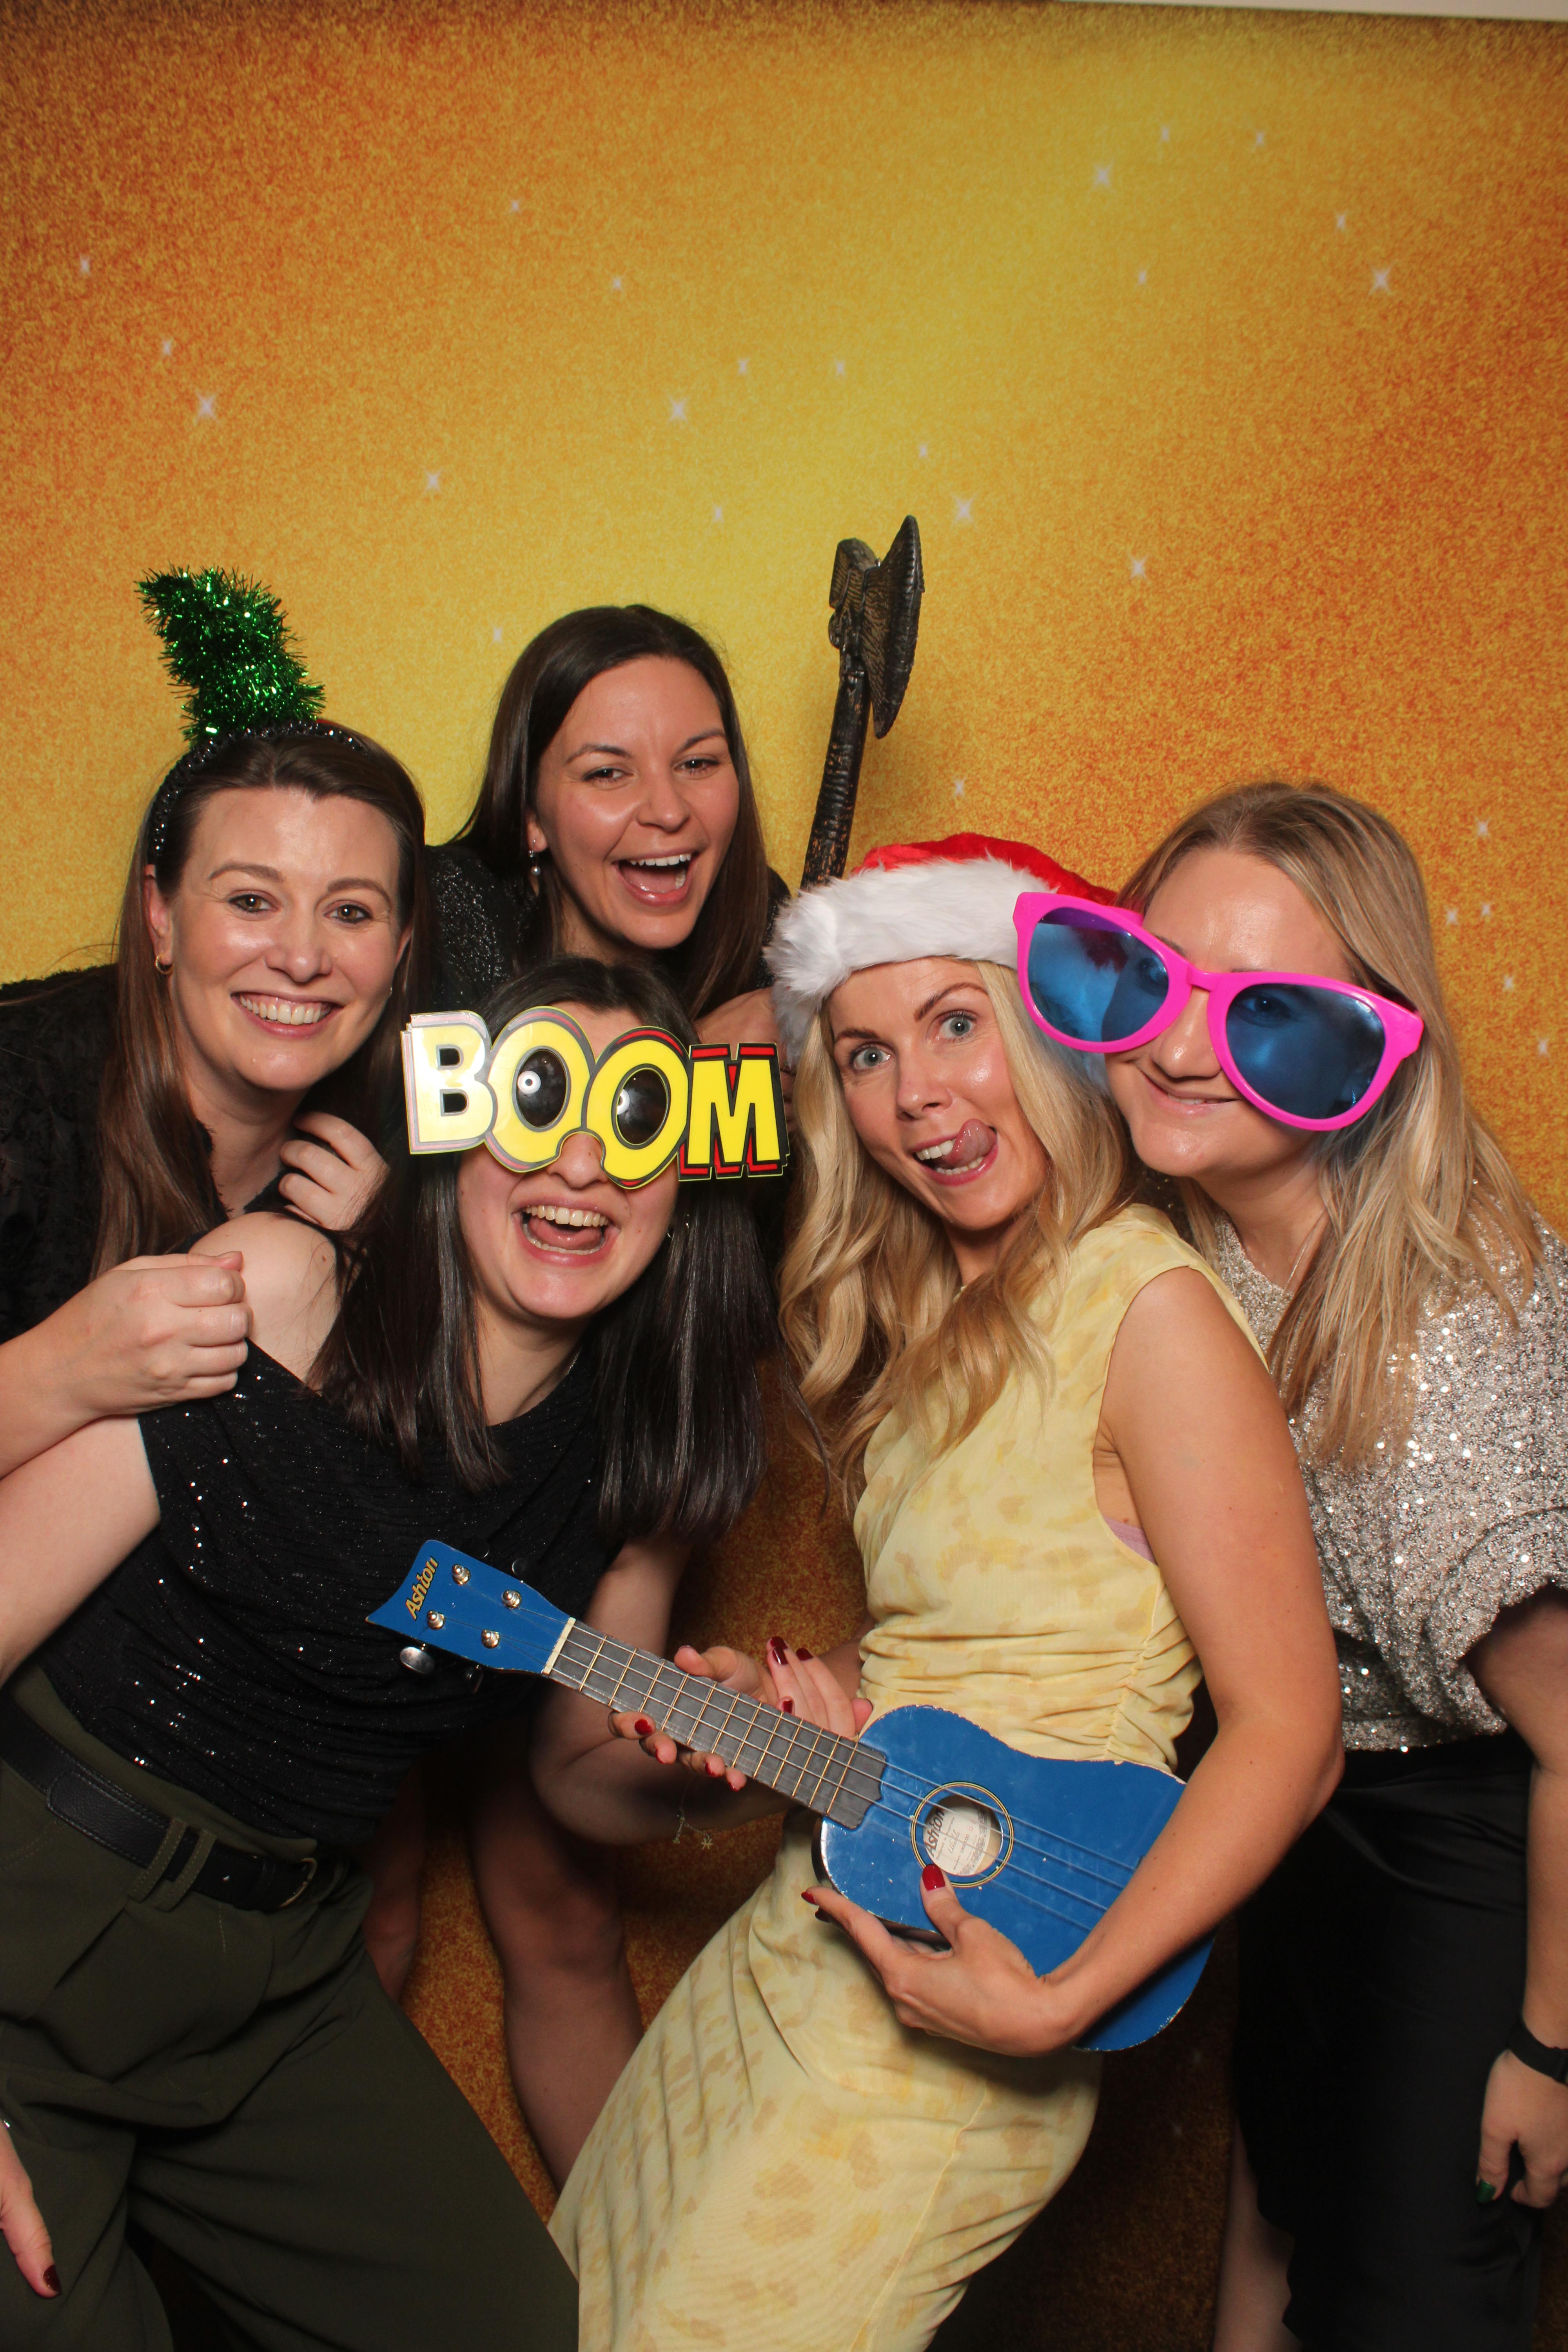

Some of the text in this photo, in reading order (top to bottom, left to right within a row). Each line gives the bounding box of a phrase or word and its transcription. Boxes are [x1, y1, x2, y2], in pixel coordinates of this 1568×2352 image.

[401, 1005, 790, 1189] BOOM
[405, 1555, 439, 1621] Ashton
[924, 1806, 945, 1858] Ashton
